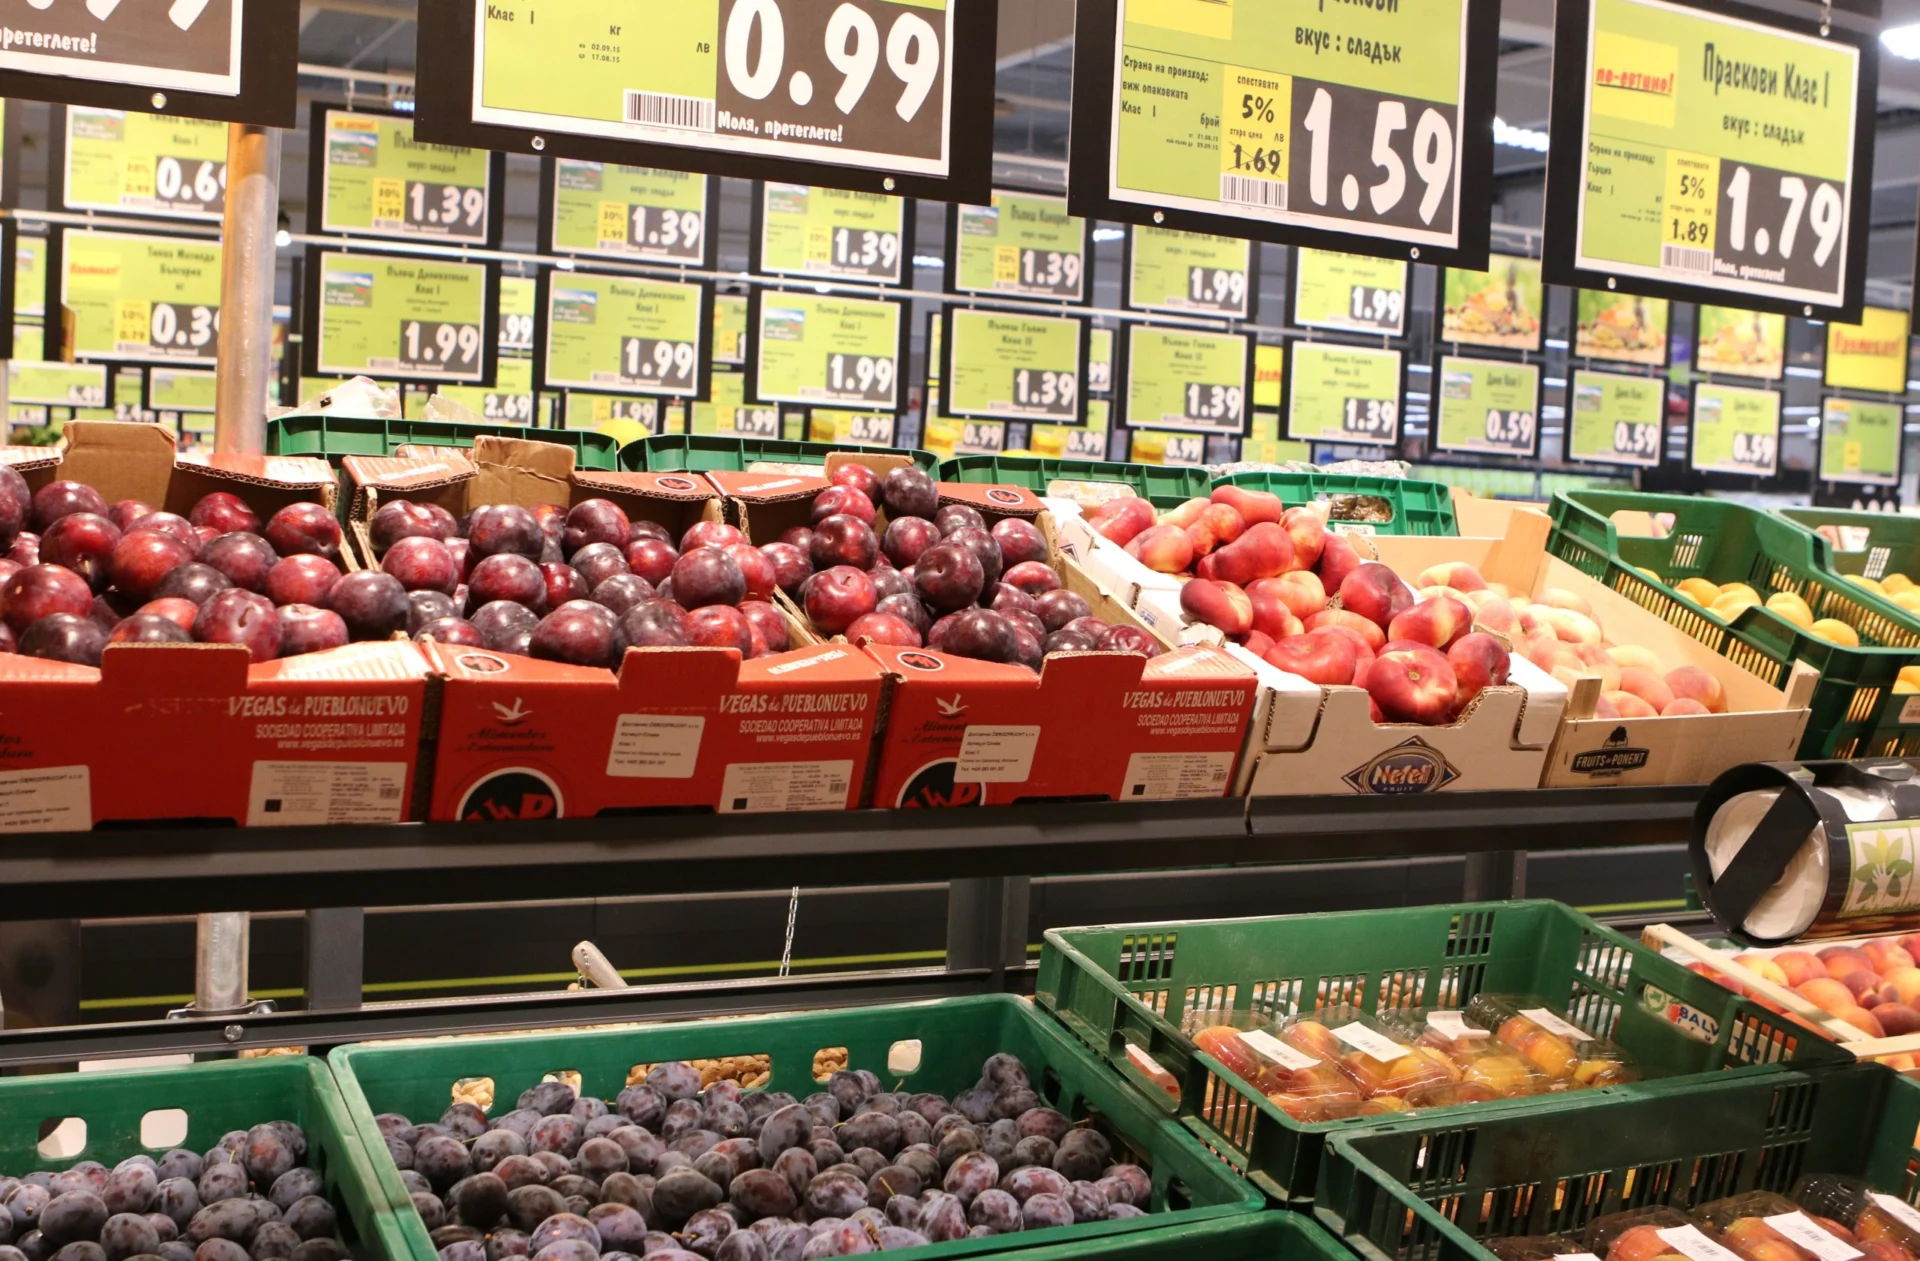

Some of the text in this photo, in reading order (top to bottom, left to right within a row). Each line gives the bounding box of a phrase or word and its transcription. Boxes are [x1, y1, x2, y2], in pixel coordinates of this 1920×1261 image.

[487, 5, 515, 21] Клас
[609, 25, 622, 36] кг
[1295, 26, 1330, 55] вкус
[1347, 33, 1402, 65] сладък
[724, 0, 940, 123] 0.99
[1123, 55, 1152, 73] Страна
[1155, 65, 1165, 75] на
[1703, 42, 1777, 97] Праскови
[1784, 63, 1818, 106] Клас
[1122, 82, 1189, 102] виж опаковката
[1237, 75, 1279, 91] спестявате
[1121, 101, 1141, 115] Клас
[1200, 113, 1220, 128] брой
[1241, 94, 1274, 123] 5%
[717, 110, 760, 135] Моля,
[764, 121, 843, 143] претеглете!
[1722, 114, 1751, 140] вкус
[1762, 123, 1805, 146] сладък
[1232, 144, 1281, 175] 1.69
[1303, 87, 1453, 225] 1.59
[1588, 141, 1612, 156] Страна
[1587, 162, 1613, 176] Гърция
[1586, 182, 1602, 194] Клас
[1680, 174, 1705, 200] 5%
[410, 182, 485, 228] 1.39
[1726, 166, 1842, 268] 1.79
[632, 205, 701, 249] 1.39
[1672, 218, 1709, 245] 1.89
[835, 226, 899, 268] 1.39
[1022, 249, 1080, 288] 1.39
[1191, 266, 1244, 304] 1.99
[1352, 286, 1401, 323] 1.99
[404, 320, 481, 365] 1.99
[625, 337, 695, 380] 1.99
[829, 353, 893, 395] 1.99
[1015, 369, 1075, 408] 1.39
[484, 393, 530, 419] 2.69
[1188, 383, 1240, 420] 1.39
[1346, 398, 1394, 432] 1.39
[735, 407, 775, 434] 1.99
[851, 415, 891, 441] 0.99
[1487, 409, 1532, 443] 0.59
[962, 423, 1001, 449] 0.99
[1615, 420, 1658, 454] 0.59
[1733, 432, 1774, 464] 0.59
[228, 695, 286, 717] VEGAS
[303, 695, 409, 717] PUEBLONUEVO
[719, 694, 767, 714] VEGAS
[780, 693, 869, 713] PUEBLONUEVO
[1122, 691, 1164, 709] VEGAS
[1172, 690, 1246, 708] PUEBLONUEVO
[739, 717, 864, 734] SOCIEDAD COOPERATIVA LIMITADA
[1137, 712, 1240, 727] SOCIEDAD COOPERATIVA LIMITADA
[1575, 754, 1607, 769] FRUITS
[1611, 752, 1646, 767] PONENT
